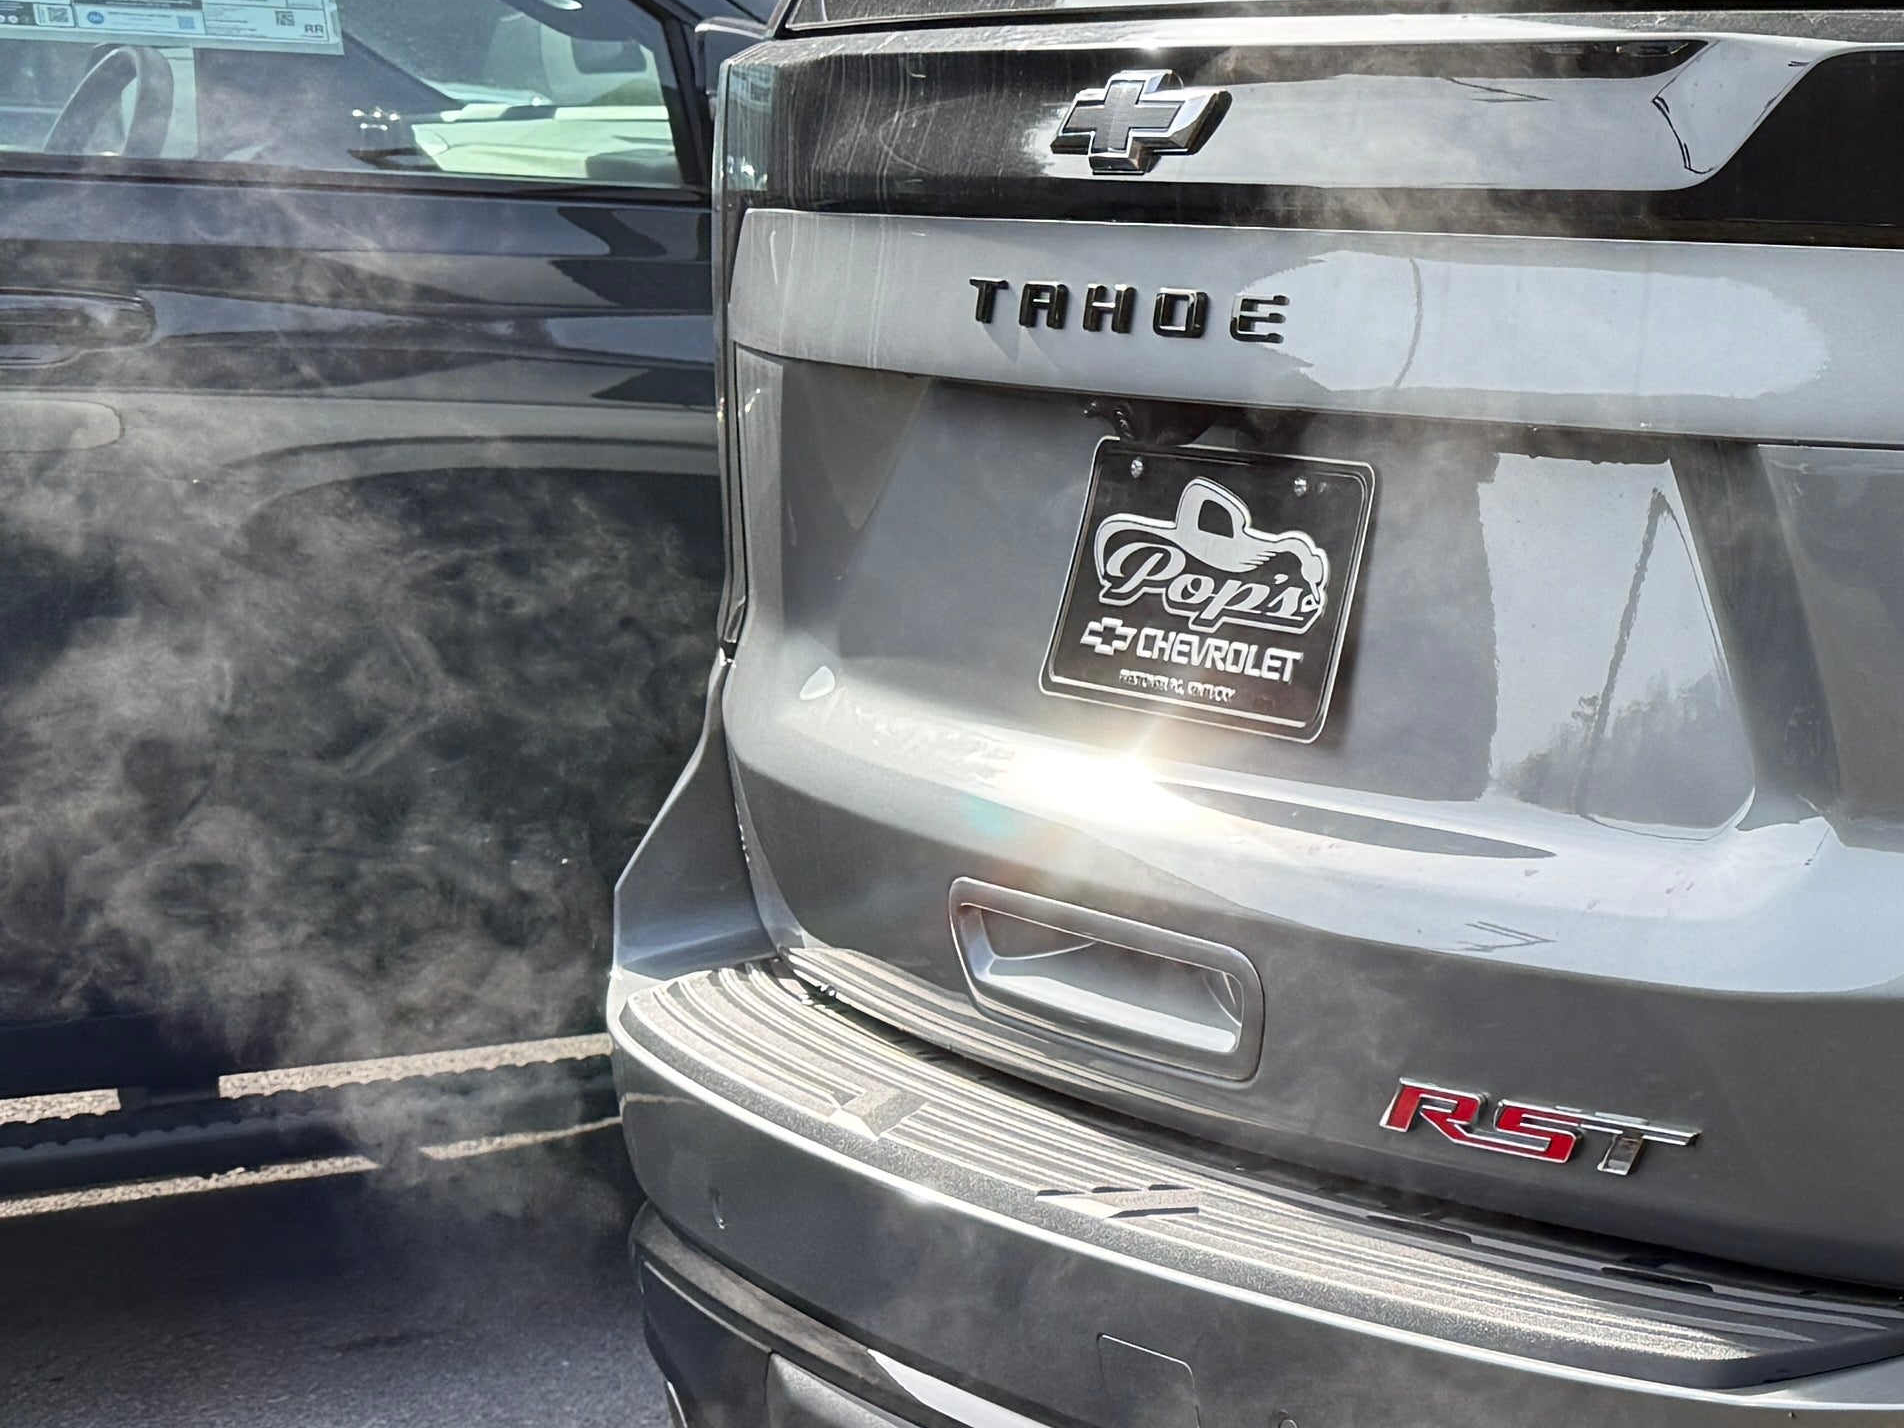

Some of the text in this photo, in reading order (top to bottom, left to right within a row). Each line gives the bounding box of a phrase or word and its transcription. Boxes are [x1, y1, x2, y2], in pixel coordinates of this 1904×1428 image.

[968, 276, 1291, 345] TAHOE
[1104, 541, 1304, 621] Pop's
[1135, 627, 1305, 684] CHEVROLET
[1379, 1077, 1702, 1176] RST
